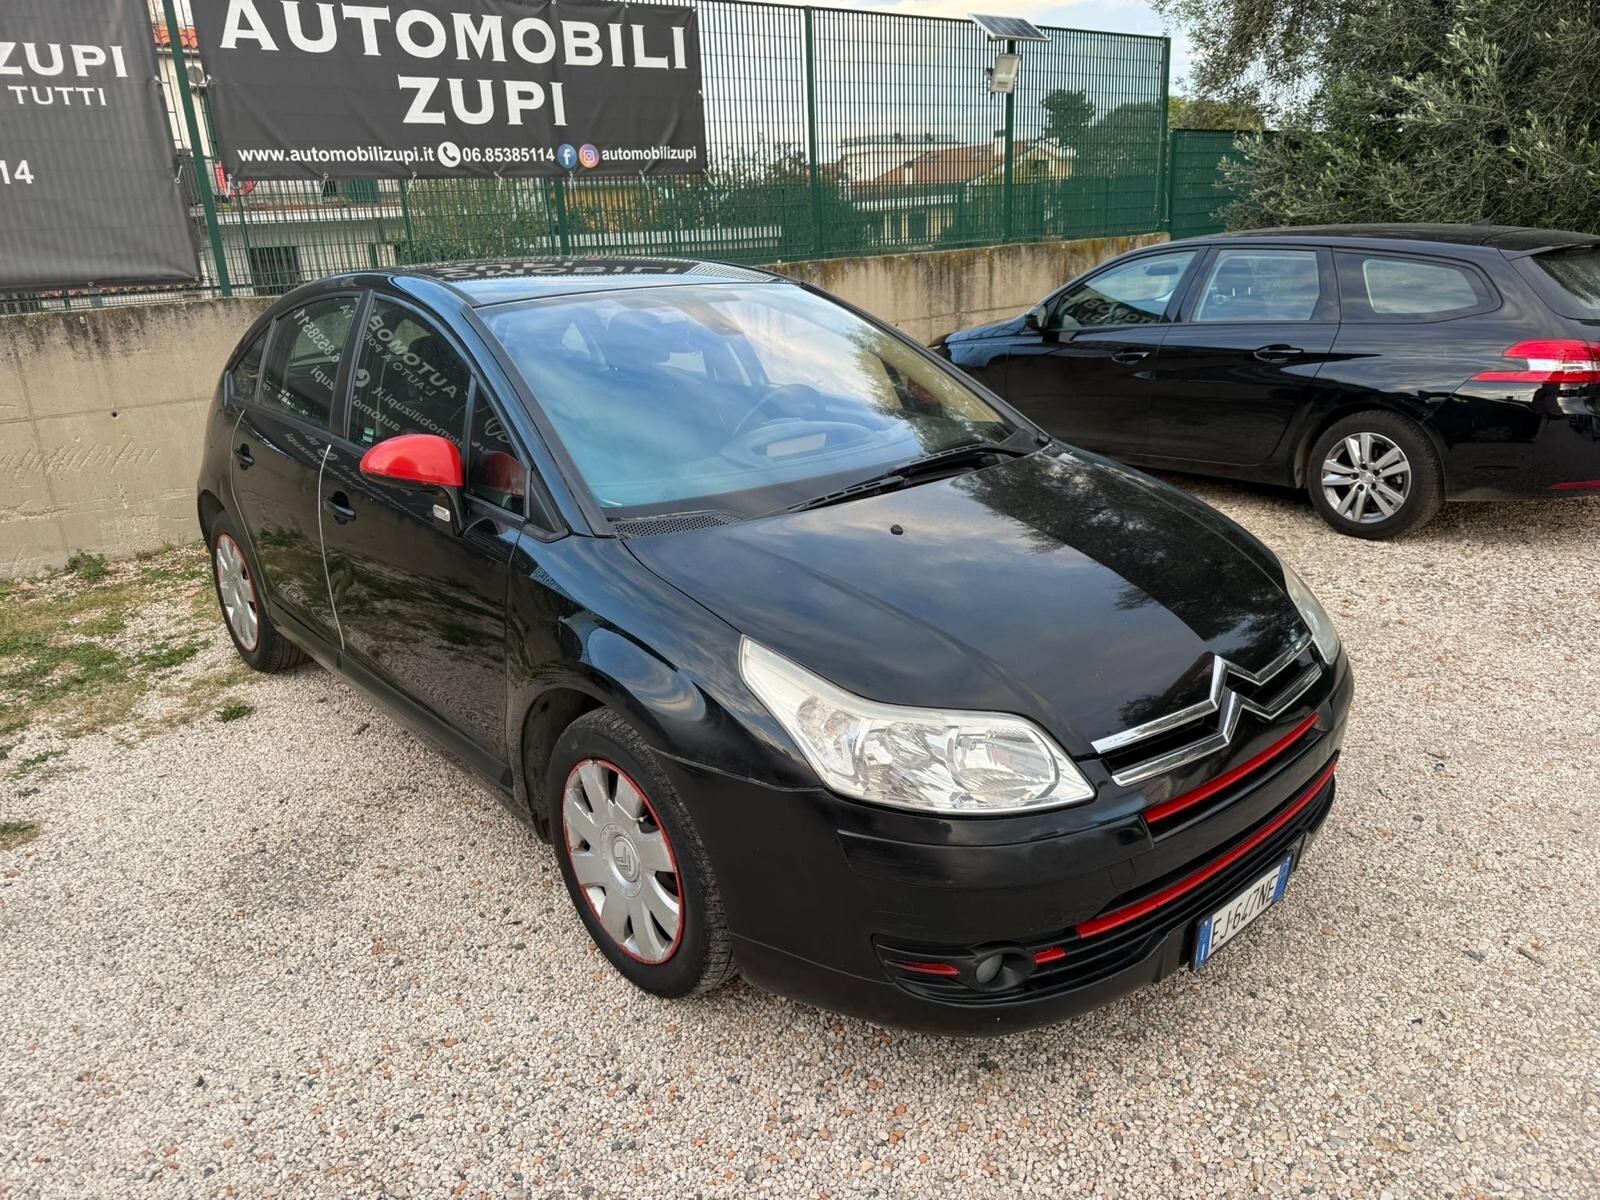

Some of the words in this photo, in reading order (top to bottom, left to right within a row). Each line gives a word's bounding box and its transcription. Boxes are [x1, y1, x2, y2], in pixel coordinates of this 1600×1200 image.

[219, 0, 688, 70] AUTOMOBILI
[0, 41, 128, 77] ZUPI
[8, 85, 107, 106] TUTTI
[397, 73, 568, 126] ZUPI
[237, 146, 435, 165] www.automobilizupi.it
[462, 147, 555, 163] 06.85385114
[602, 146, 697, 163] automobilizupi
